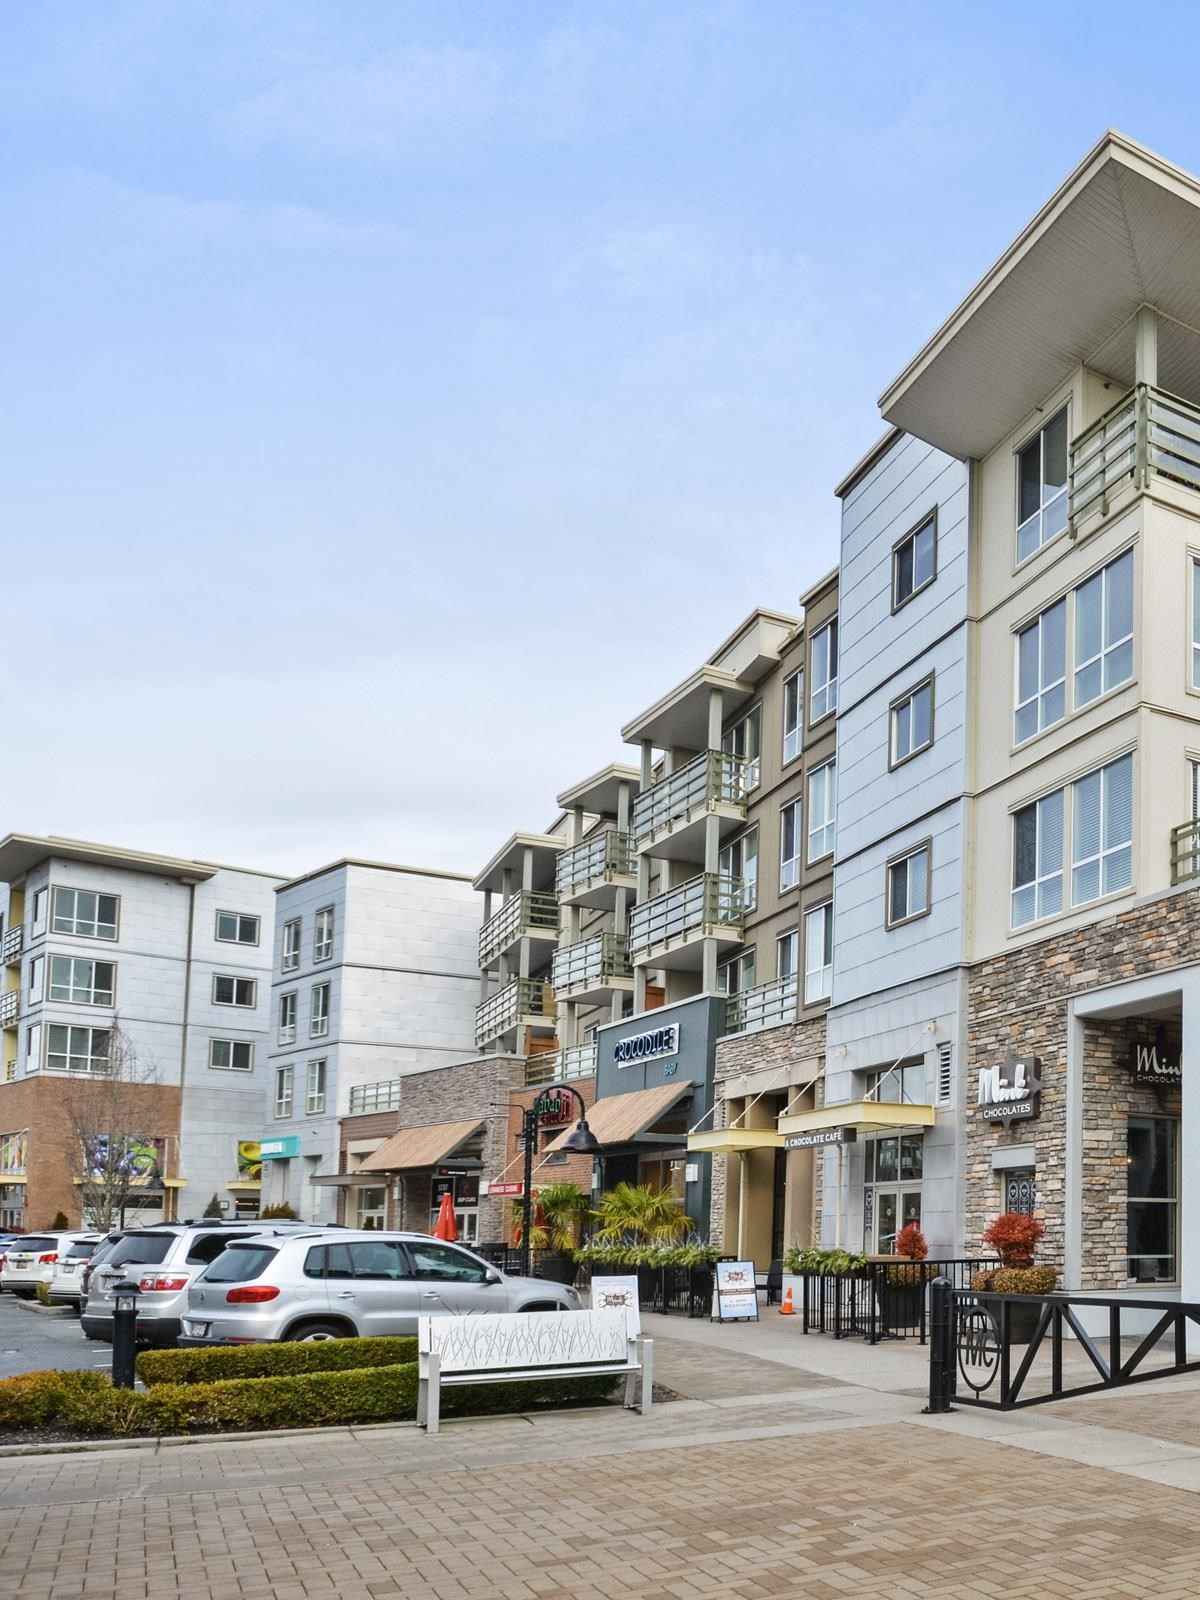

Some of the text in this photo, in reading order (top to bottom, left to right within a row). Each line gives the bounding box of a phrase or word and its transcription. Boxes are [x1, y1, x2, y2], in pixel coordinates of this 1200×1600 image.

[614, 1027, 672, 1062] CROCODILE
[1137, 1074, 1181, 1083] CHOCOLAT
[983, 1103, 1031, 1119] CHOCOLATES
[785, 1130, 842, 1148] A CHOCOLATE CAFÉ
